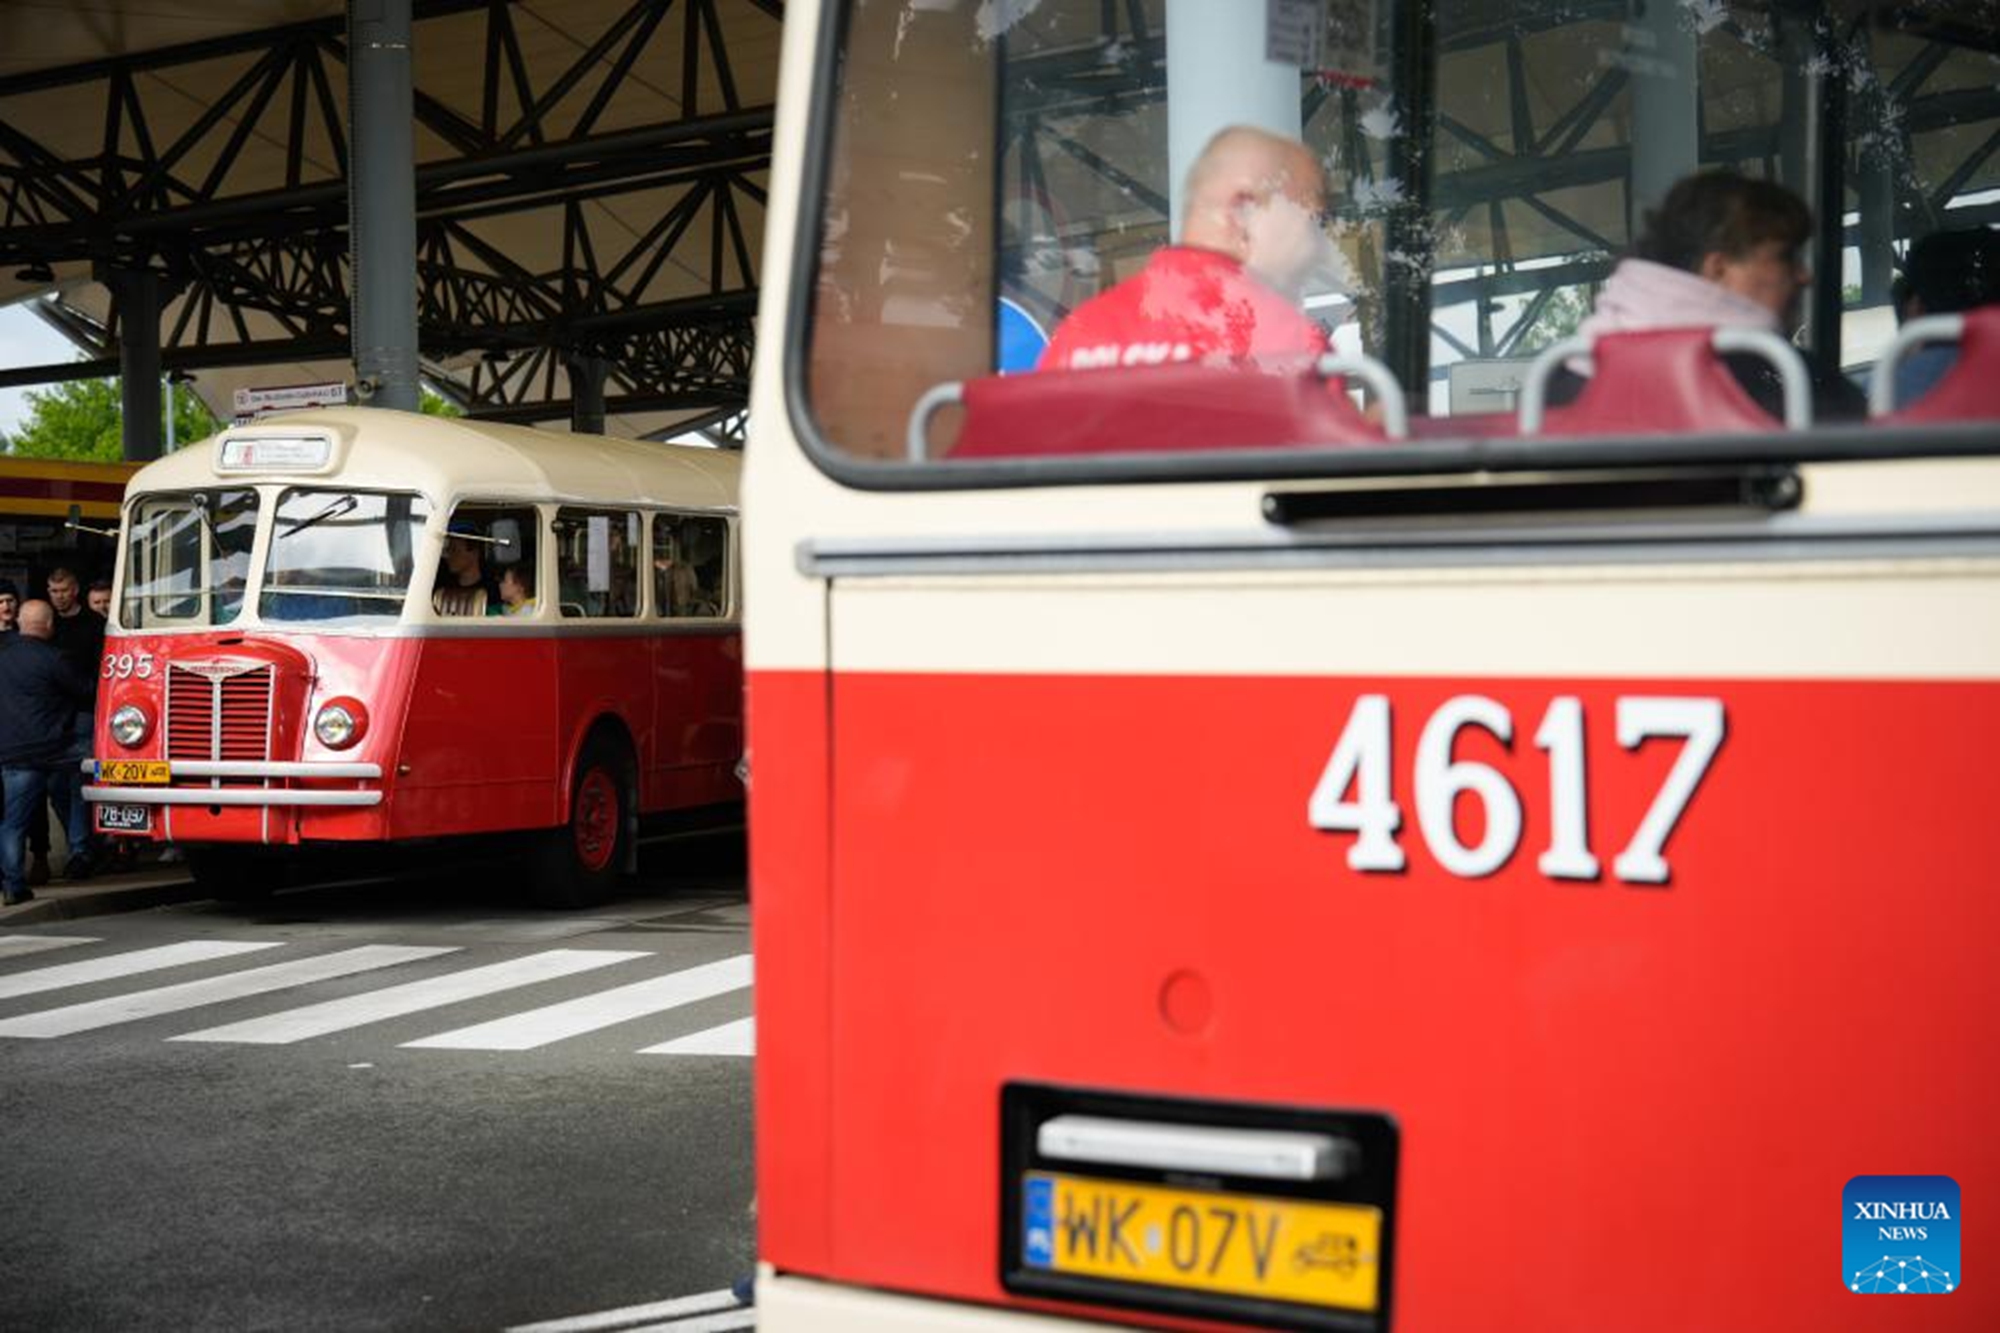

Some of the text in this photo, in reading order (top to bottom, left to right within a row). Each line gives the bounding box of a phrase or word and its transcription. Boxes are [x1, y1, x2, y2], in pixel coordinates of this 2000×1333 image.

[102, 653, 154, 679] 395
[123, 763, 148, 780] 20V
[1308, 694, 1726, 883] 4617
[1061, 1189, 1280, 1281] WK 07V
